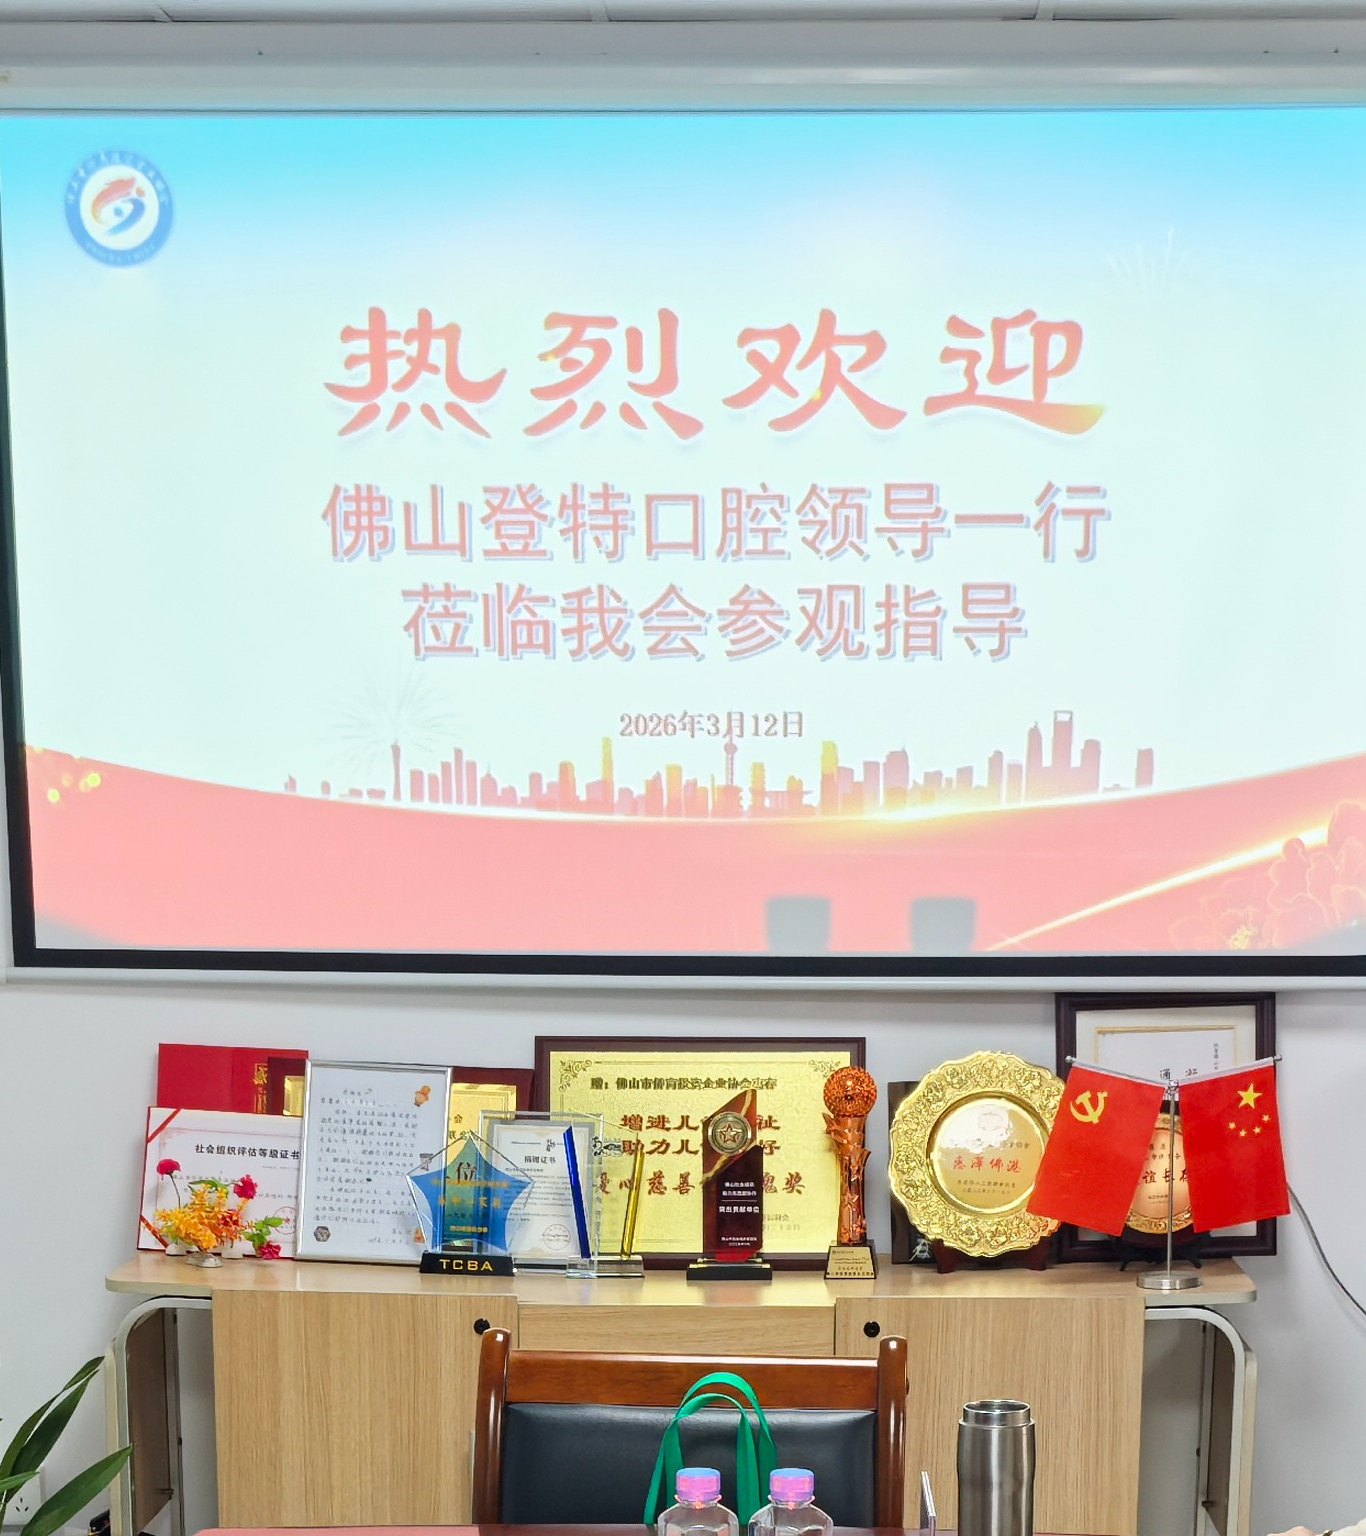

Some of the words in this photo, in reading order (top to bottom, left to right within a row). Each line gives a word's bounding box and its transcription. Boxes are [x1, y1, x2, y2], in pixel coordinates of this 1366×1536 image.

[324, 305, 1107, 441] 热烈欢迎
[322, 480, 1110, 563] 佛山登特口腔领导一行
[400, 582, 1032, 662] 莅临我会参观指导
[619, 708, 806, 742] 2026年3月12日
[195, 1143, 301, 1161] 社会组织评估等级证书
